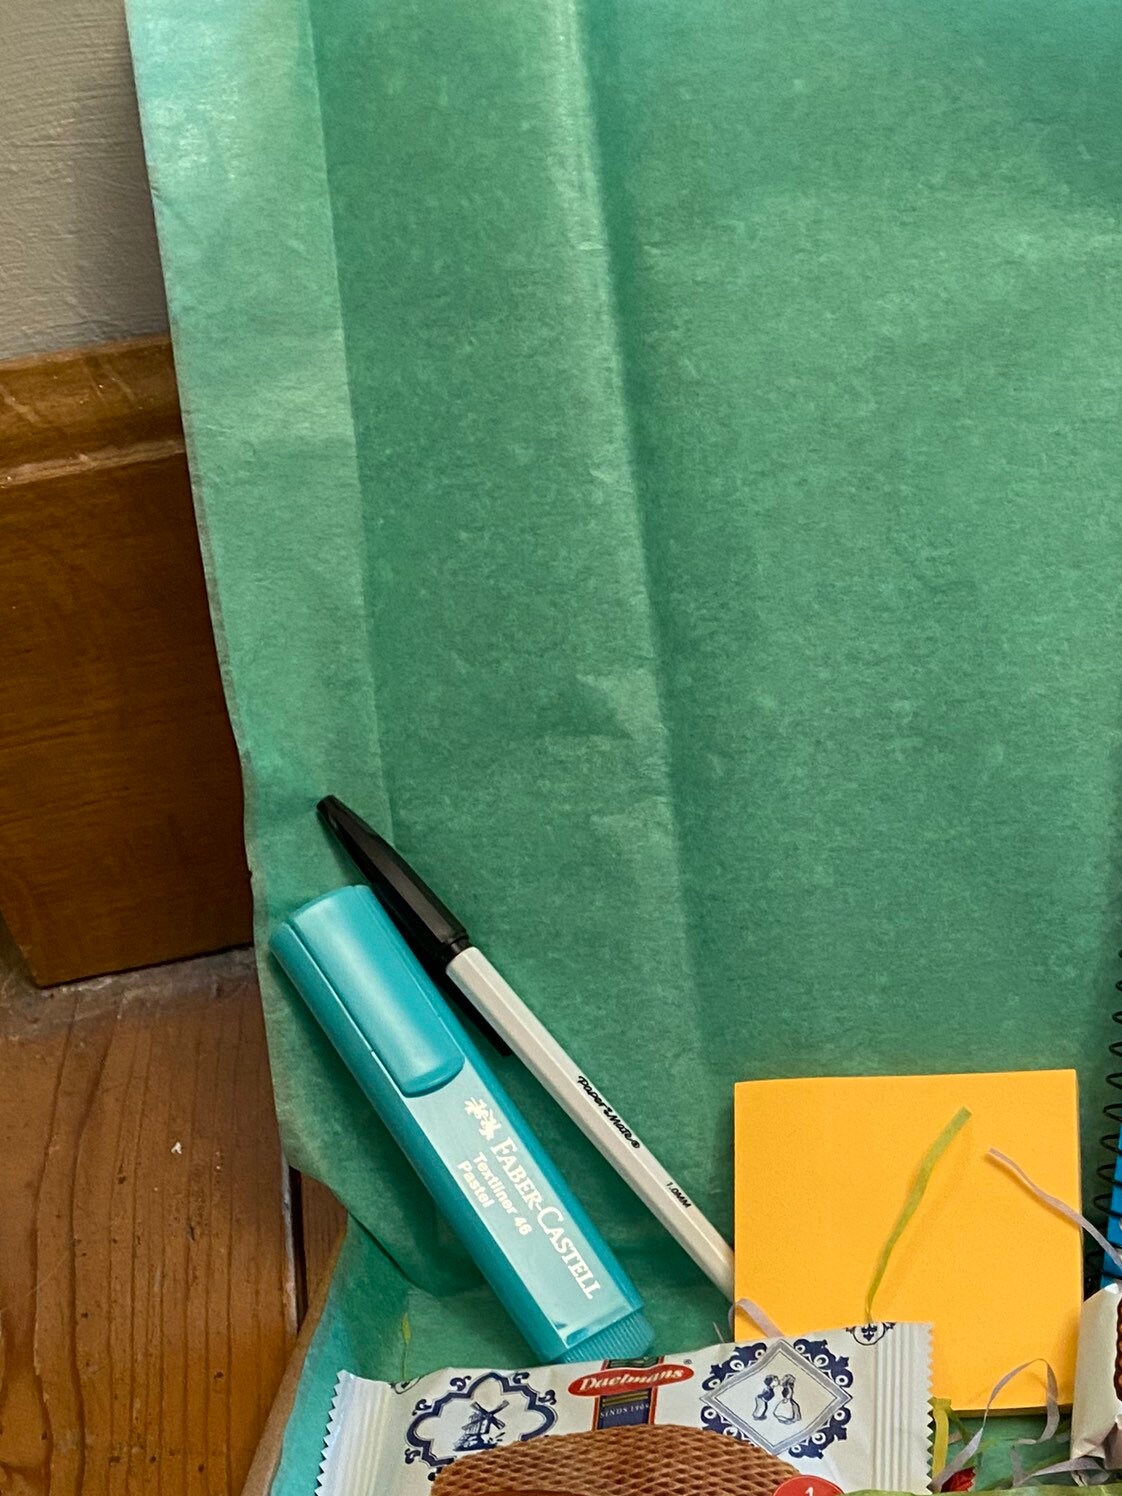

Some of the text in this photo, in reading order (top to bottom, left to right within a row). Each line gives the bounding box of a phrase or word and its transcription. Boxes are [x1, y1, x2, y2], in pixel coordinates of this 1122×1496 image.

[457, 1160, 495, 1208] Pastel
[473, 1152, 533, 1236] Textliner 46
[490, 1136, 601, 1300] FABER-CASTELL
[578, 1368, 684, 1392] Daelmans
